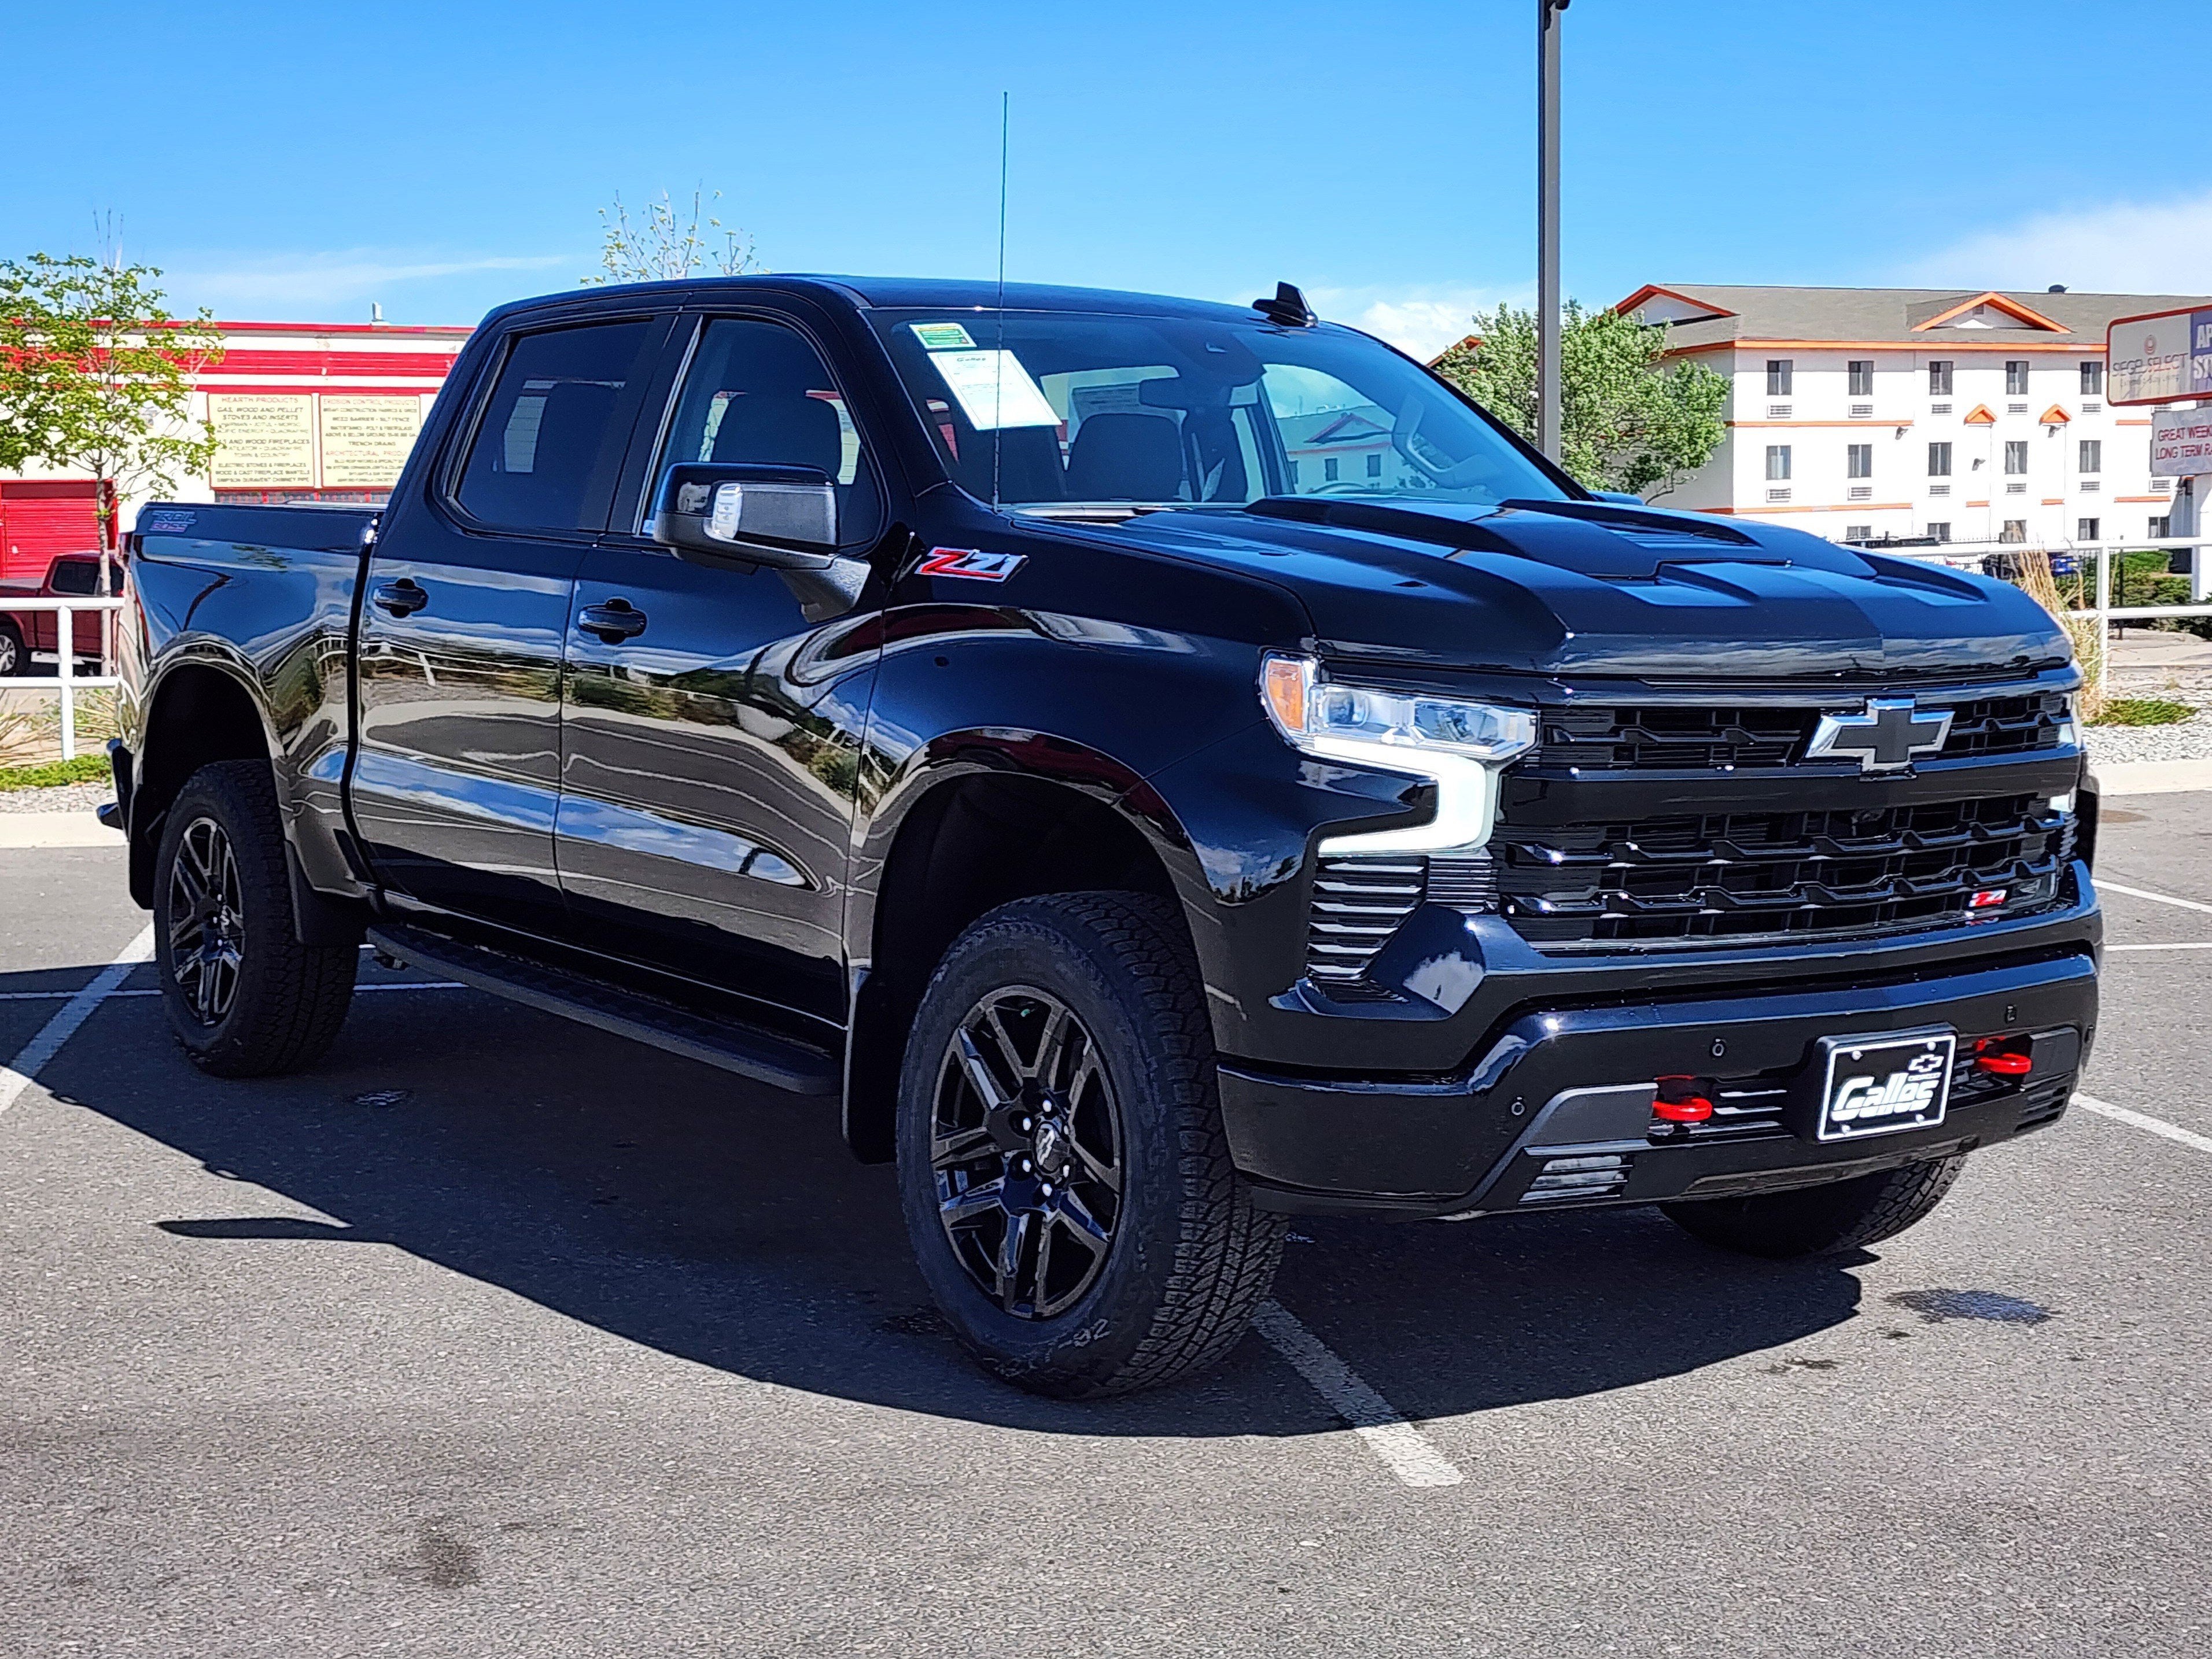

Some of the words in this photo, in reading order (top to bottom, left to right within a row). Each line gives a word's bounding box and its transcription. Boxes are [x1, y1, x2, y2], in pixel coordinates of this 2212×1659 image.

[2158, 427, 2185, 441] GREAT
[2156, 446, 2178, 460] LONG
[2180, 444, 2203, 458] TERM
[915, 547, 1028, 583] Z71
[1831, 1072, 1939, 1121] Galles
